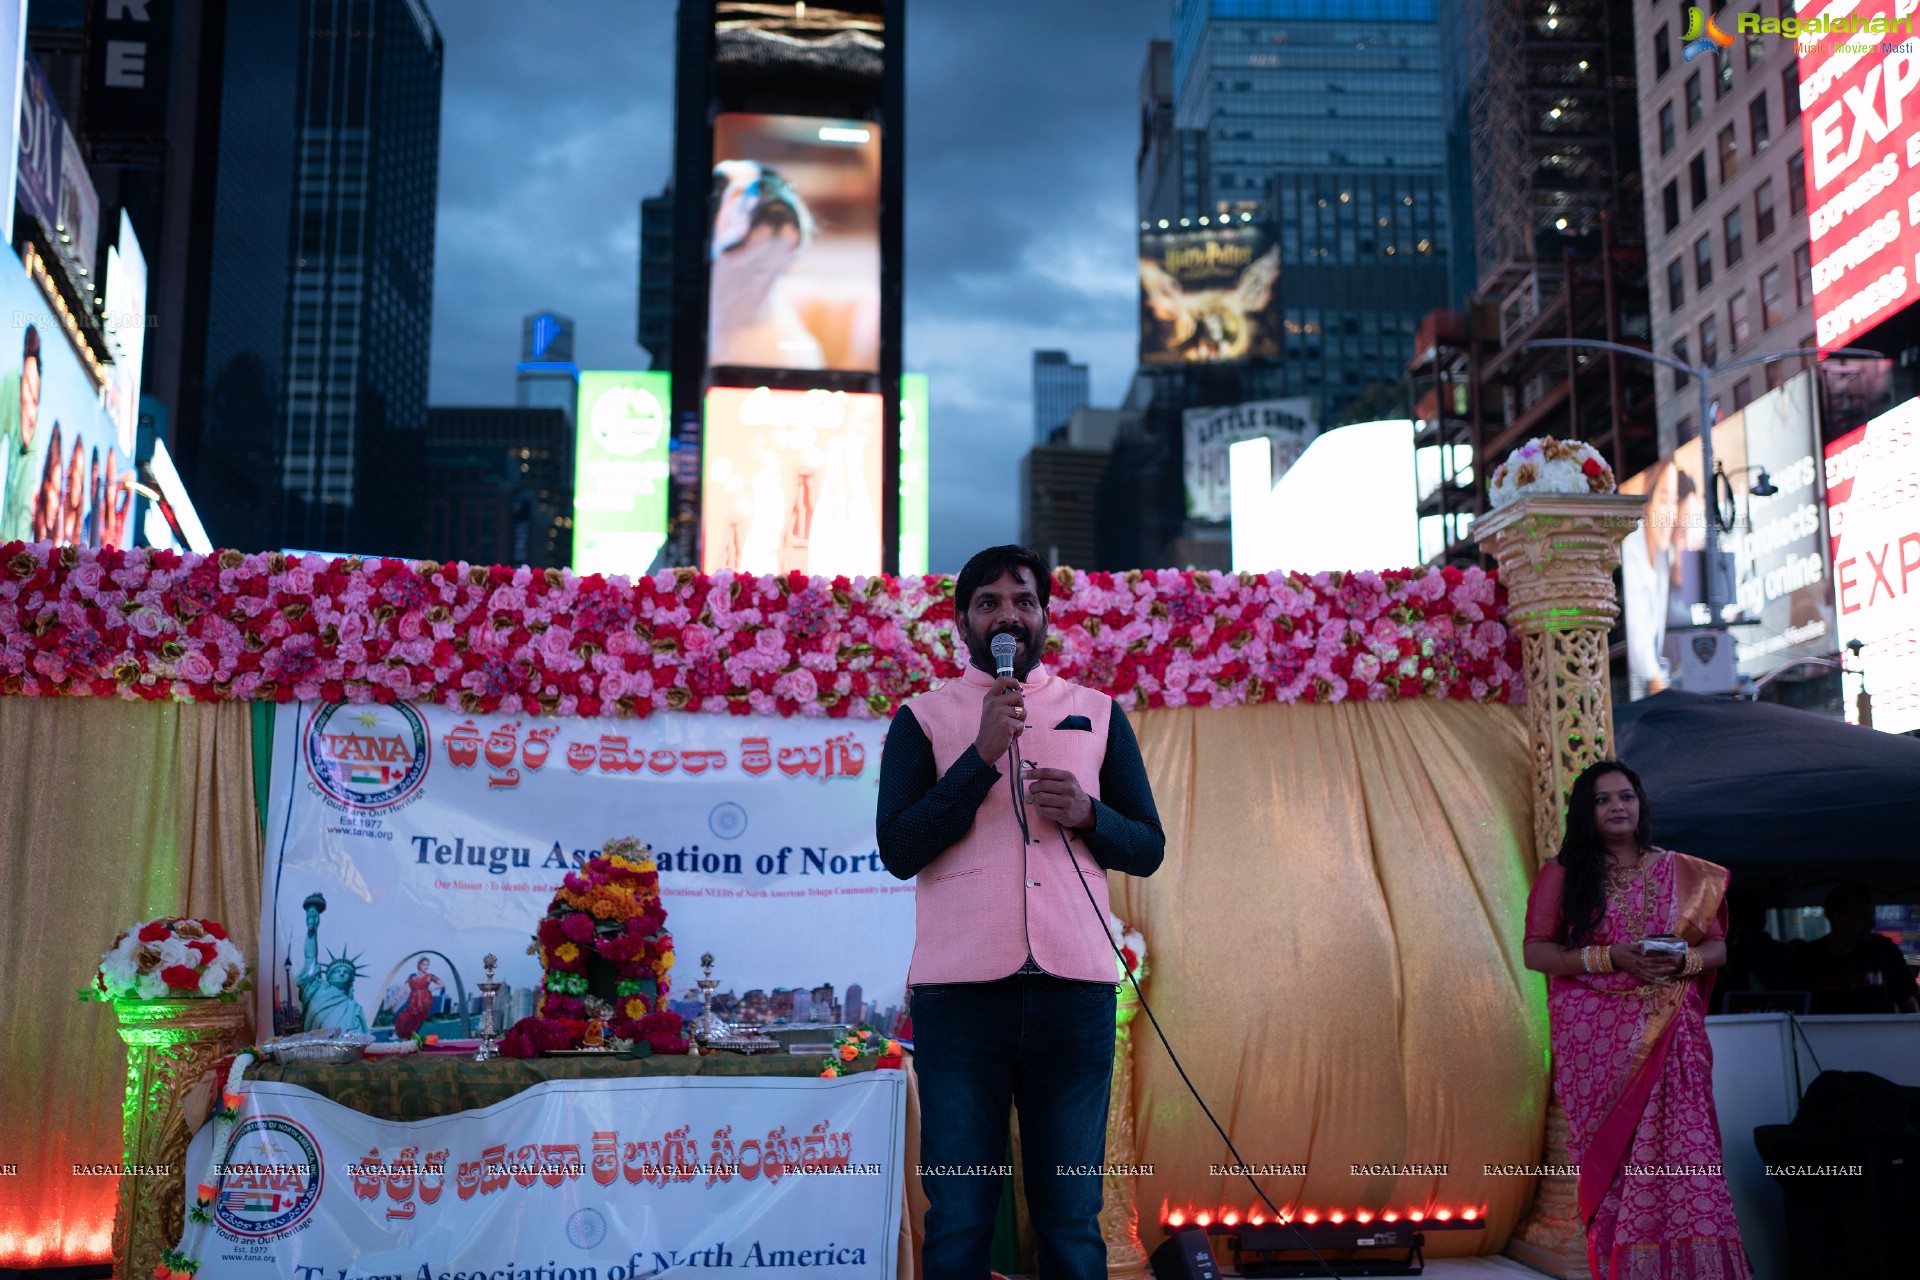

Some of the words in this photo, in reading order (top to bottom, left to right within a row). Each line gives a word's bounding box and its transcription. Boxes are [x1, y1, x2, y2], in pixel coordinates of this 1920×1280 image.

[1744, 503, 1819, 566] protects
[1765, 552, 1822, 601] online
[321, 731, 414, 763] TANA
[740, 731, 866, 783] తెలుగు
[307, 781, 322, 798] Our
[322, 794, 349, 814] Youth
[352, 808, 366, 817] are
[368, 808, 387, 818] Our
[388, 787, 426, 813] Heritage
[327, 826, 394, 841] www.tana.org
[360, 818, 383, 829] 1977
[411, 835, 531, 875] Telugu
[541, 841, 743, 873] Assation
[755, 846, 793, 875] of
[800, 847, 890, 875] Nort
[435, 879, 451, 889] Our
[452, 880, 482, 891] Mission
[501, 881, 530, 893] identify
[532, 882, 547, 893] and
[661, 887, 703, 897] ducational
[278, 1122, 299, 1138] NORTH
[225, 1160, 306, 1193] TANA
[215, 1224, 239, 1245] Youth
[241, 1237, 256, 1246] are
[257, 1235, 276, 1246] Our
[277, 1217, 314, 1241] Heritage
[222, 1253, 276, 1263] www.tana.org
[250, 1246, 268, 1254] 1977
[607, 1253, 642, 1280] of
[652, 1242, 733, 1275] Nrth
[740, 1240, 867, 1268] America
